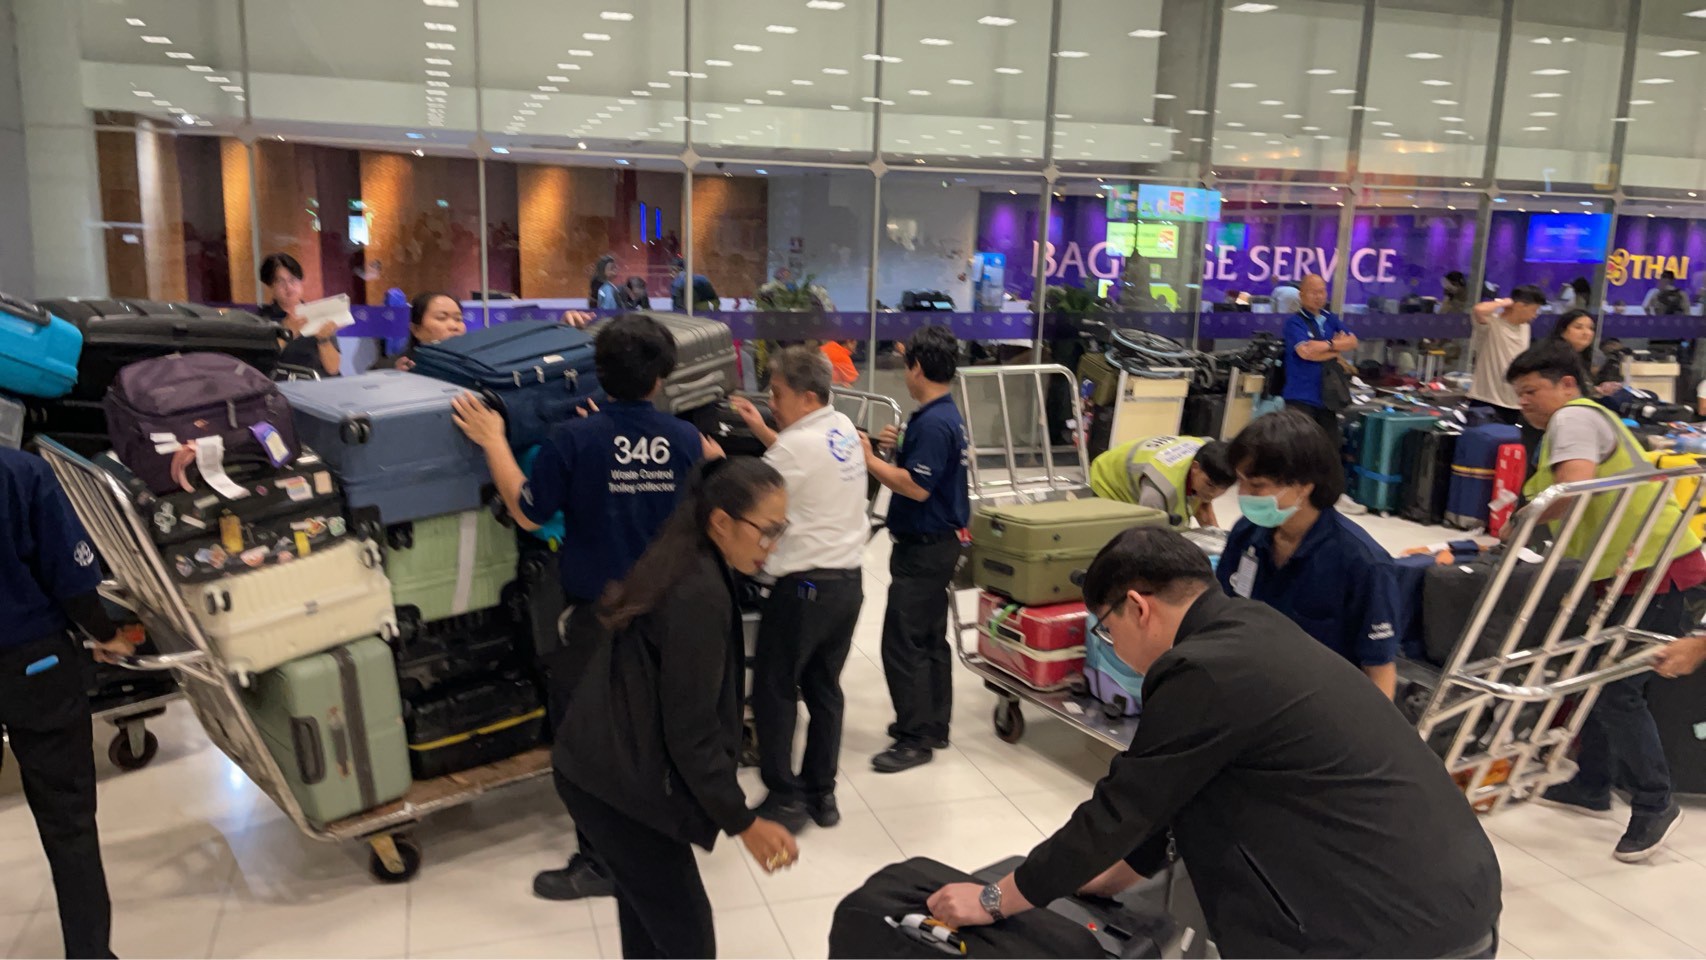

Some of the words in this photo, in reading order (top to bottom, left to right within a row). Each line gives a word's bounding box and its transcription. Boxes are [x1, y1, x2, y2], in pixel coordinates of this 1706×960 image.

[1248, 245, 1397, 284] SERVCE
[1630, 254, 1690, 280] THAI
[614, 435, 671, 465] 346
[611, 469, 639, 480] Waste
[640, 468, 674, 480] Control
[608, 482, 636, 494] Trolley
